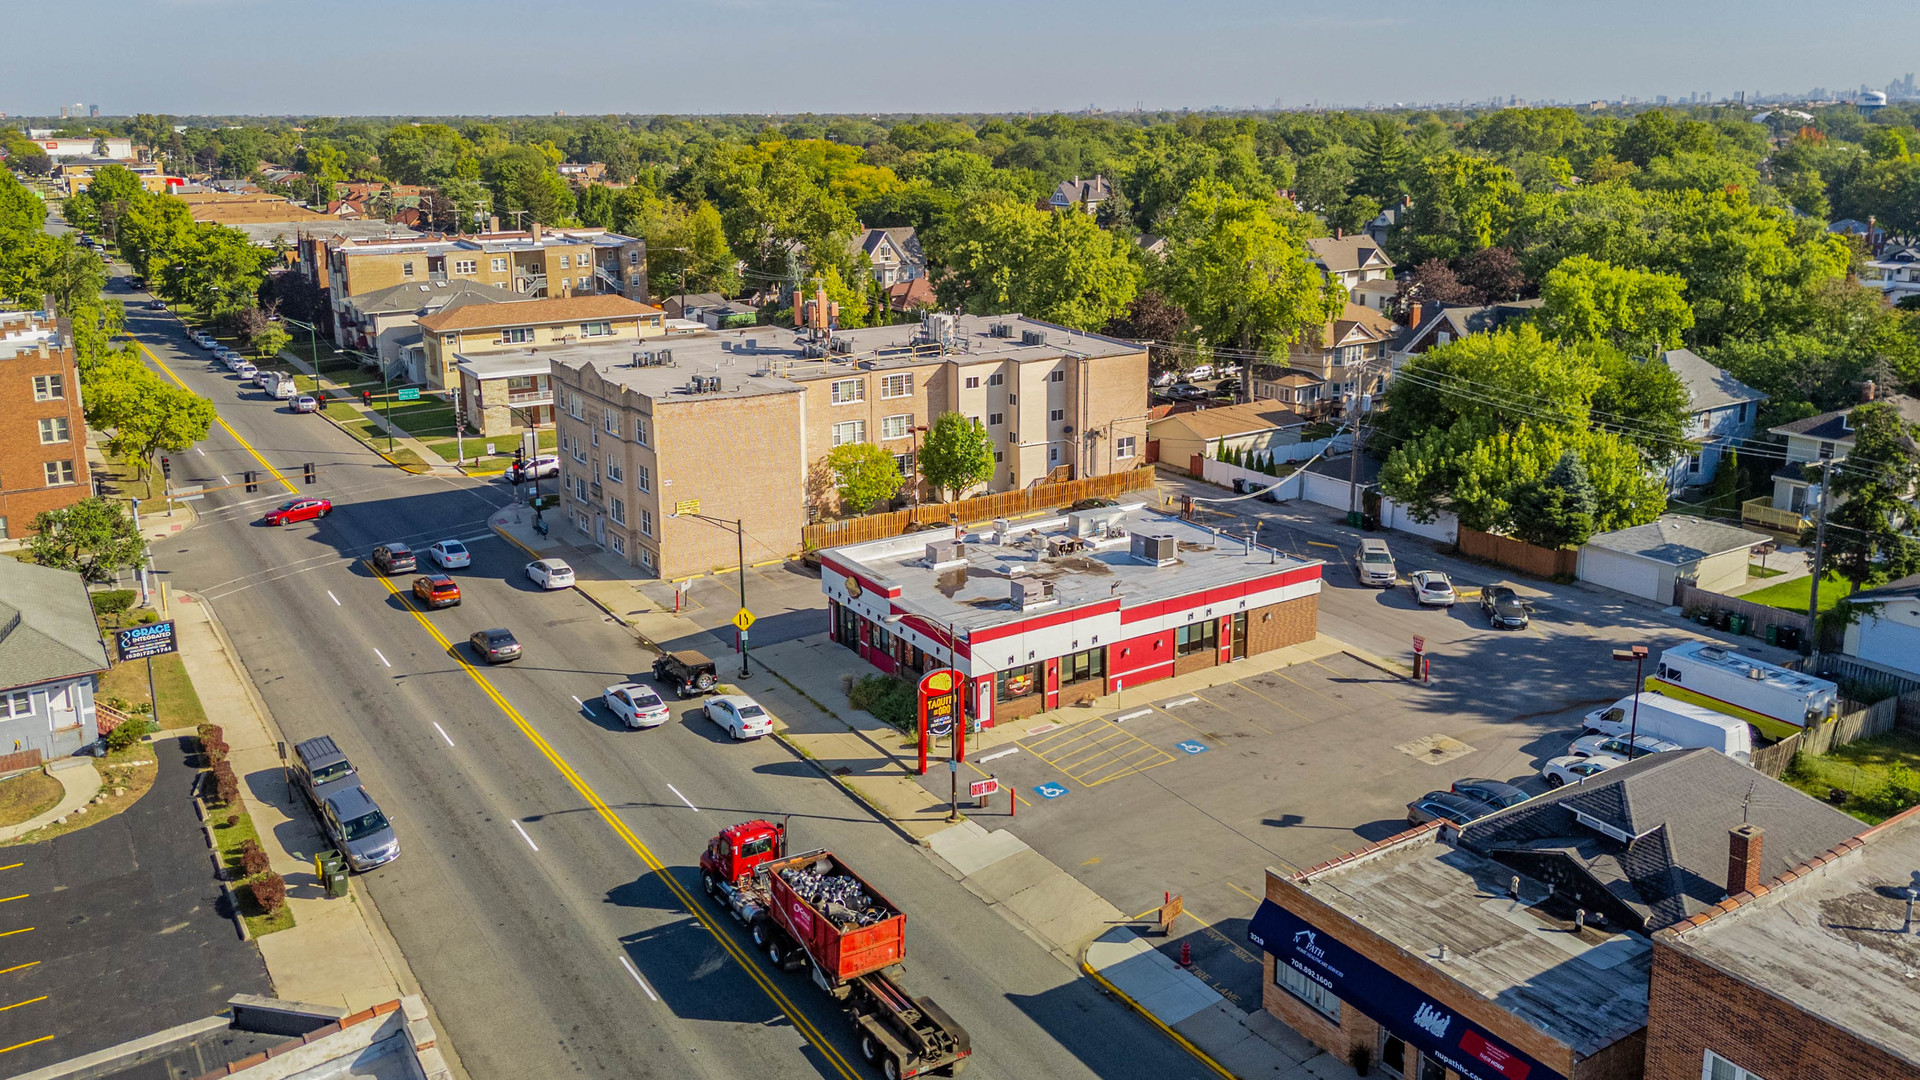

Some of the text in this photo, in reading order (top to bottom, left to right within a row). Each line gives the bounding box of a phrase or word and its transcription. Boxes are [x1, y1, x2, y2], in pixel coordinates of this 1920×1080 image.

[132, 624, 171, 637] GRACE
[132, 632, 171, 643] INTEGRATED
[938, 704, 951, 716] ORO
[972, 783, 983, 796] DRIVE
[1305, 942, 1325, 958] PATH
[1290, 958, 1333, 989] 708.892.1600
[1188, 965, 1242, 1001] FIRE LANE
[1434, 1050, 1483, 1080] nupathhc.co
